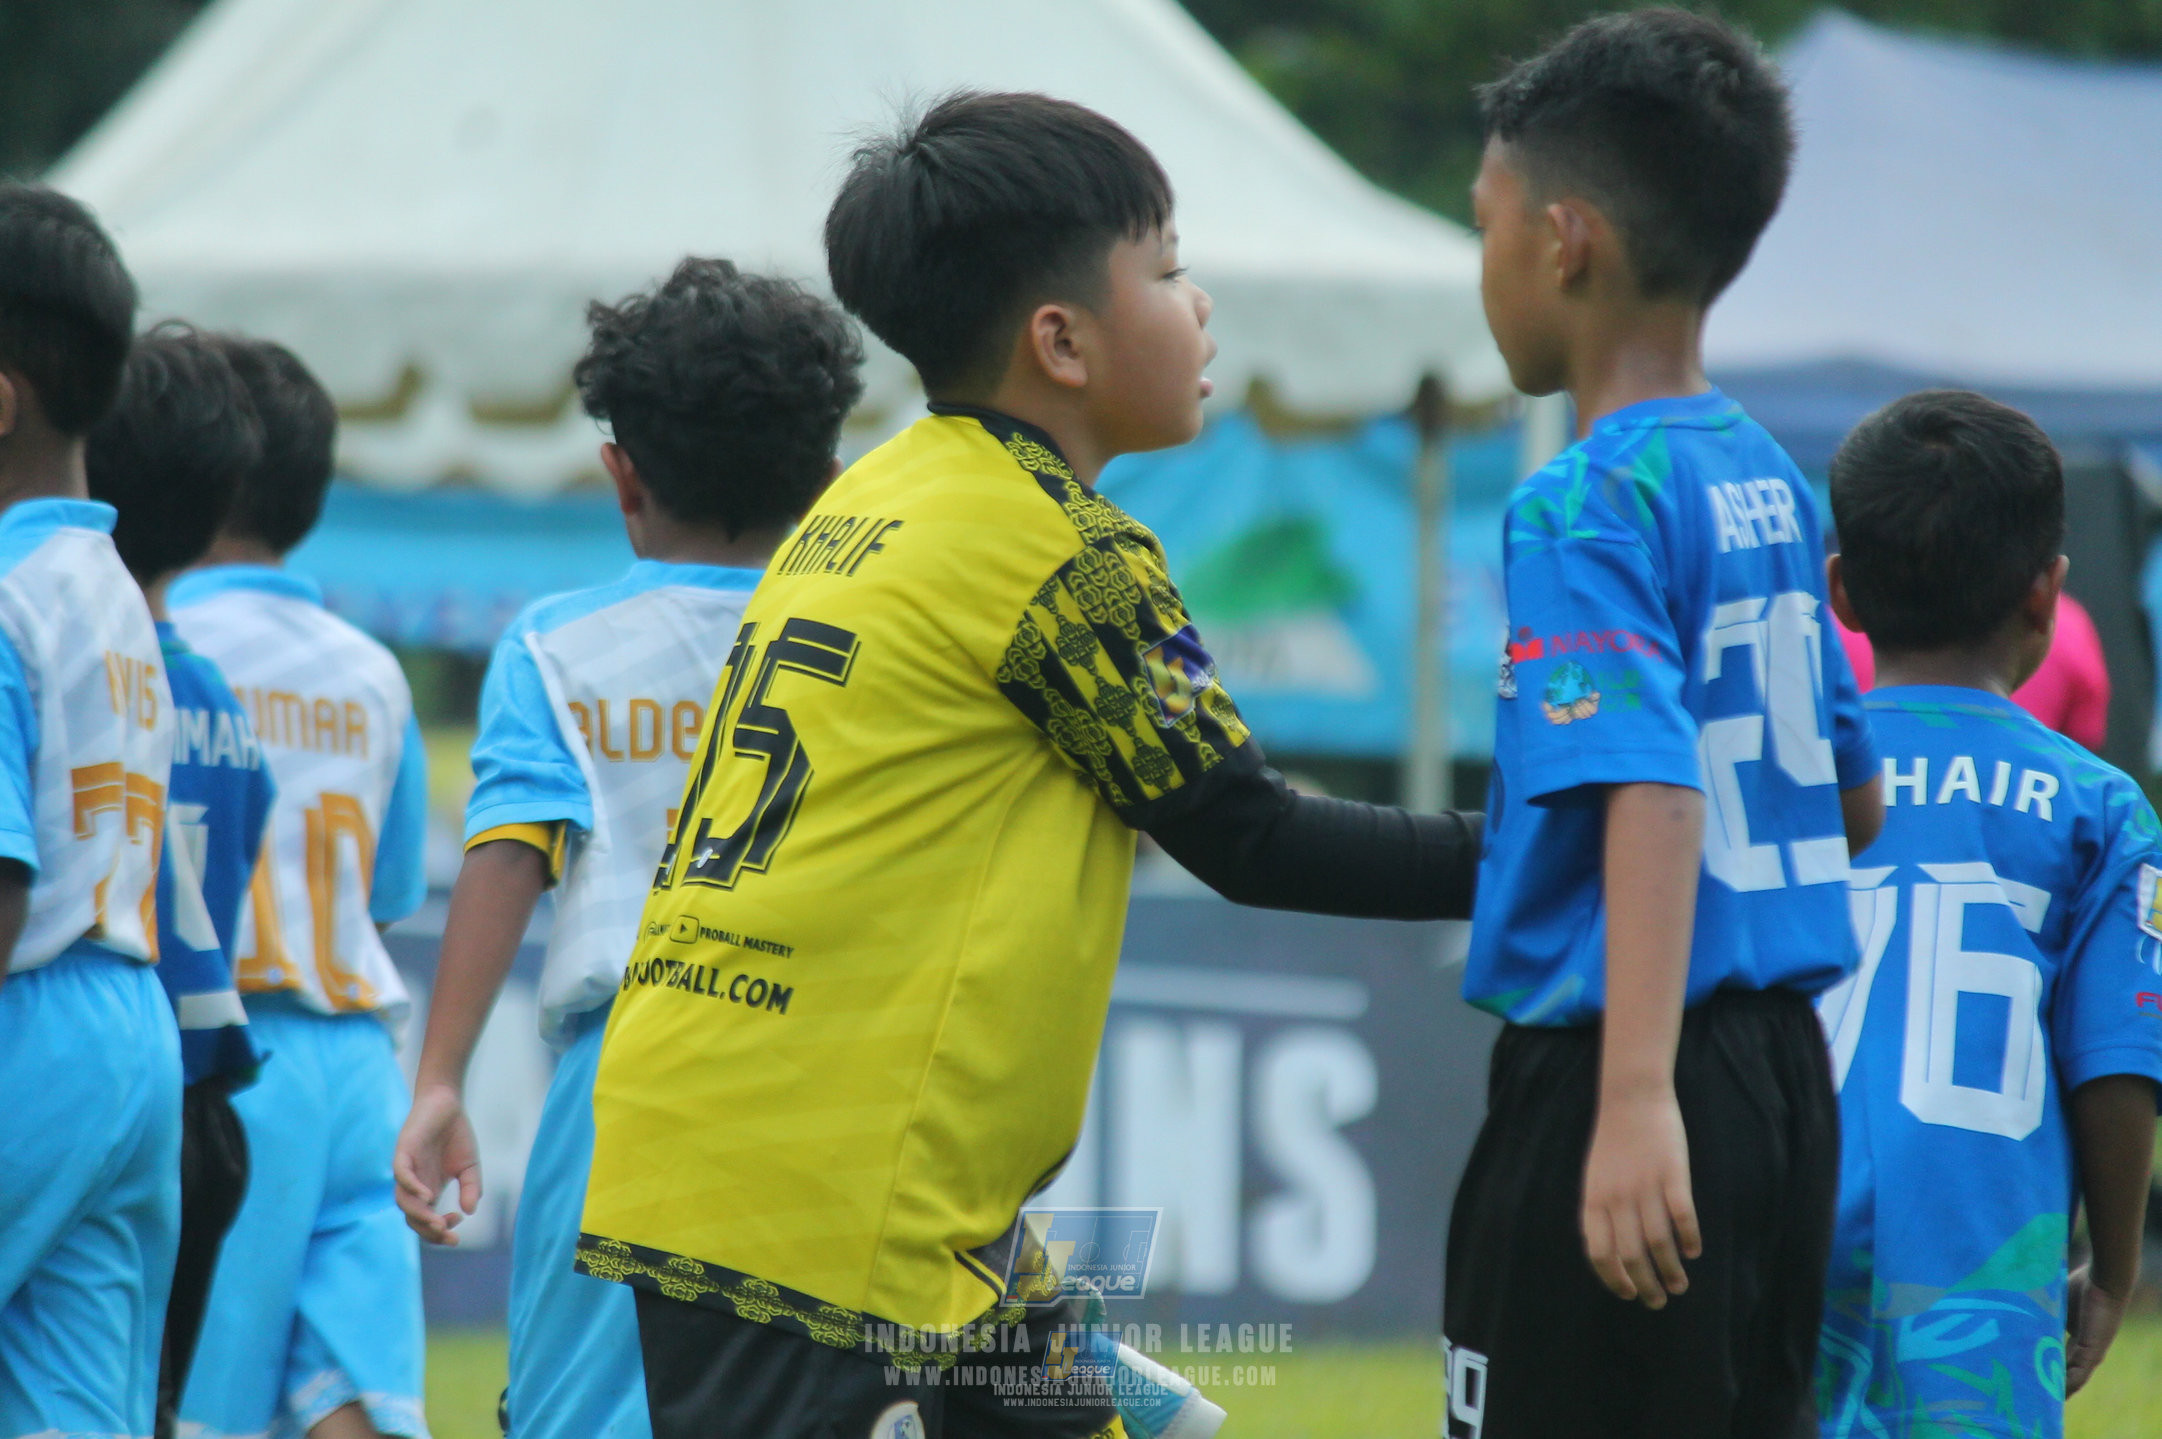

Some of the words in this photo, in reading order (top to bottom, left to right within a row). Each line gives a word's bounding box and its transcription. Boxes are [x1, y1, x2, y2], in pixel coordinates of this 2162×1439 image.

[777, 514, 905, 577] KHALIF
[1709, 478, 1803, 554] ASHER
[1701, 590, 1852, 893] 29
[1882, 756, 2060, 823] HAIR
[699, 926, 741, 948] PROBALL
[742, 935, 796, 959] MASTERY
[1817, 861, 2052, 1142] 76
